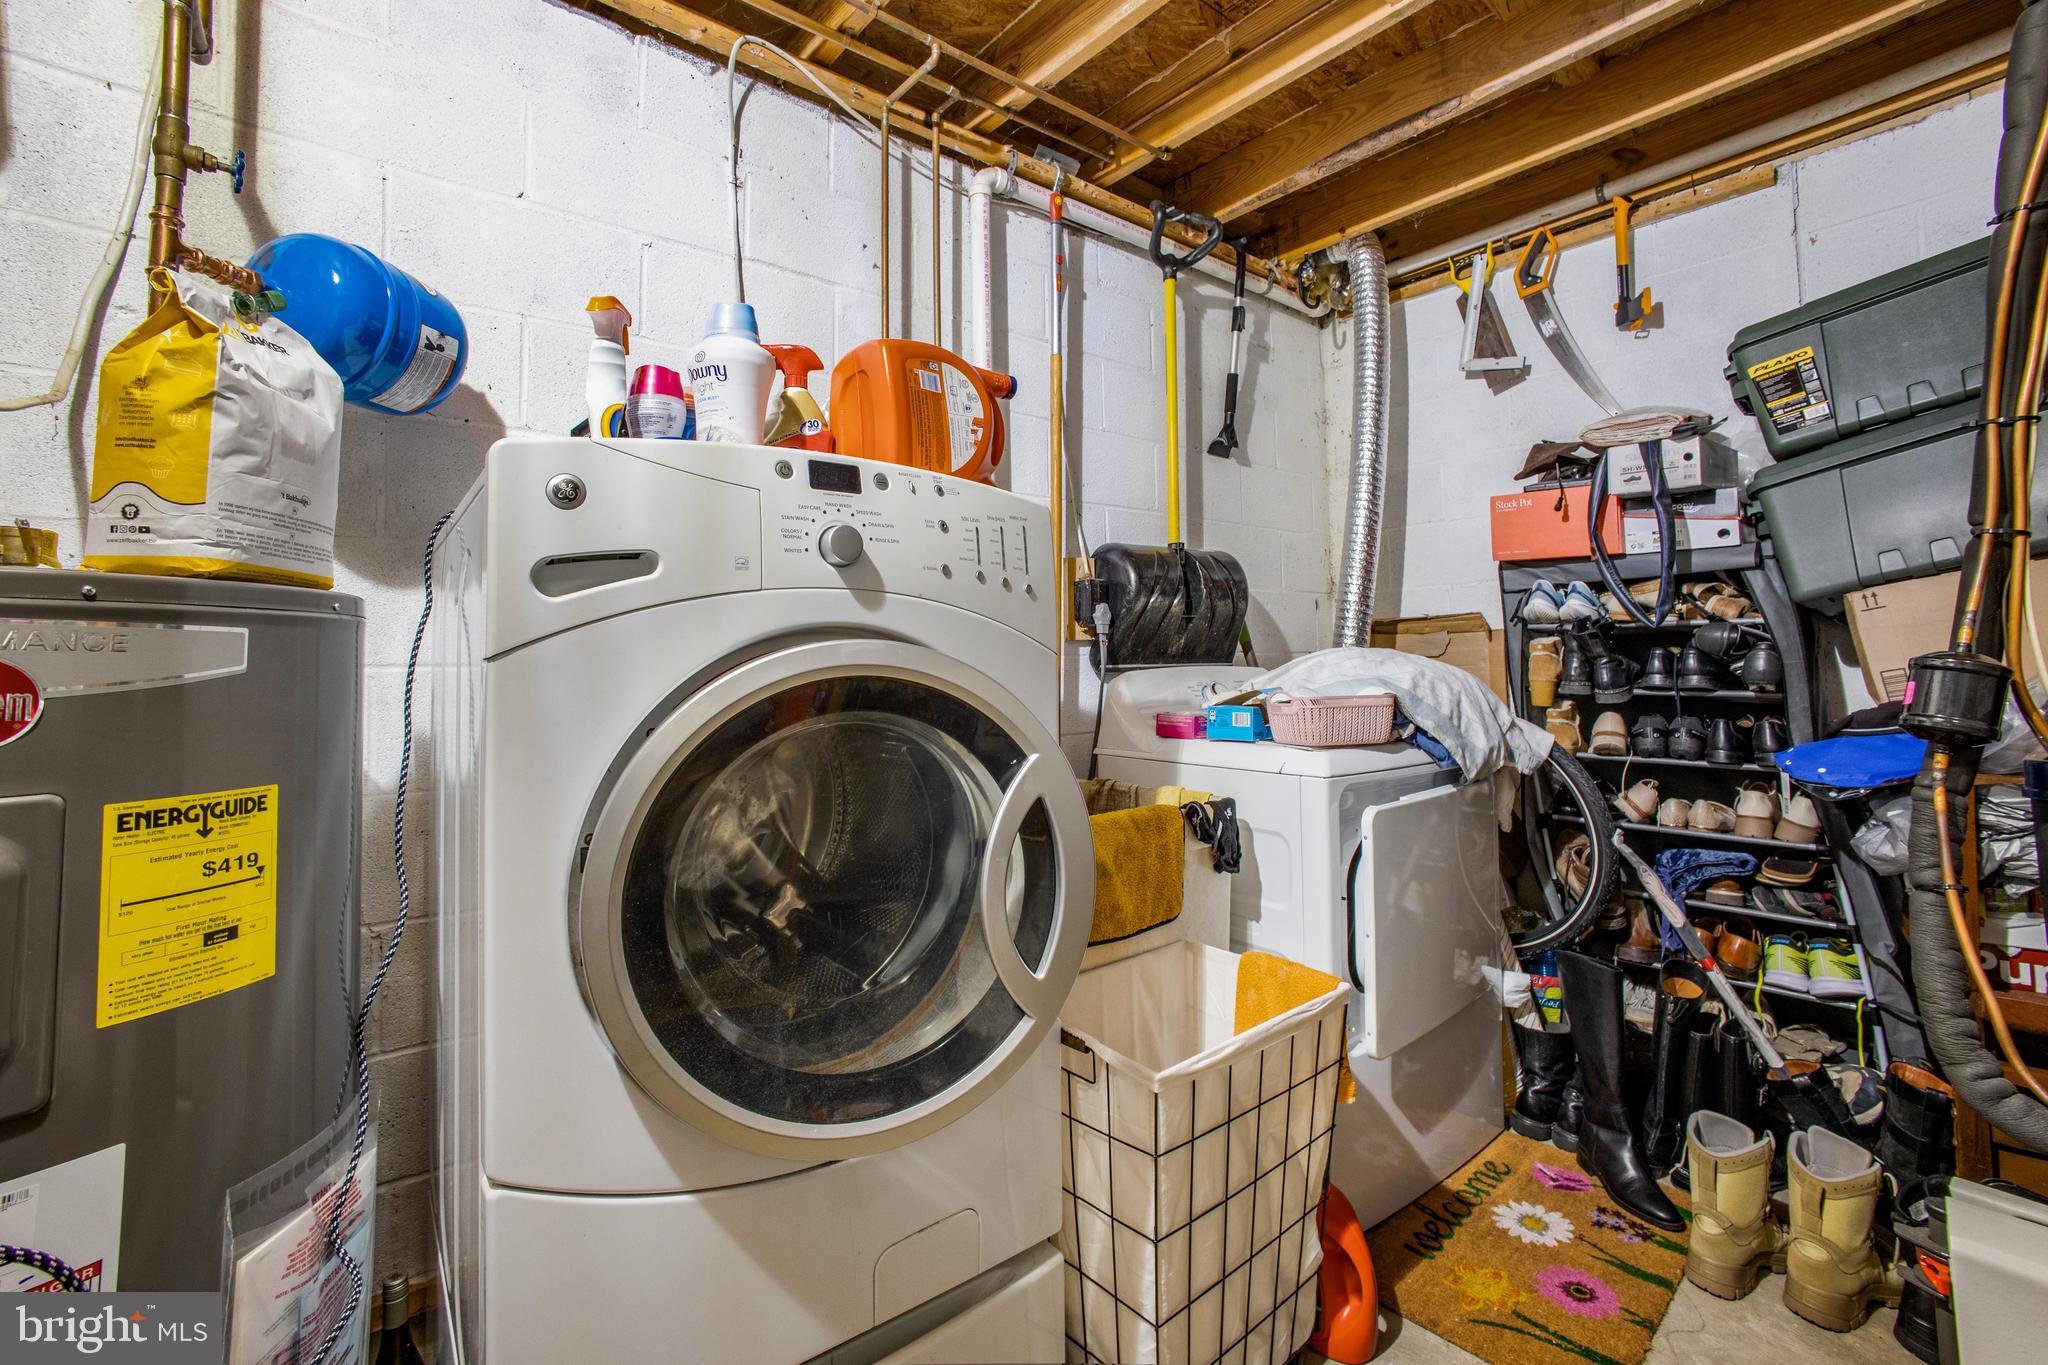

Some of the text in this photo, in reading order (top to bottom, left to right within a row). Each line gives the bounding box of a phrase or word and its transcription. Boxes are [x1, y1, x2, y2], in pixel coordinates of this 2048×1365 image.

[1753, 351, 1808, 375] PLANO
[807, 420, 819, 428] 30
[1495, 497, 1533, 509] Stock Pot
[116, 794, 269, 839] ENERGYGUIDE
[148, 841, 239, 864] Estimated Yearly Energy Cost
[202, 852, 259, 878] $419
[175, 913, 227, 931] First Hour Rating
[1404, 1160, 1512, 1260] welcome
